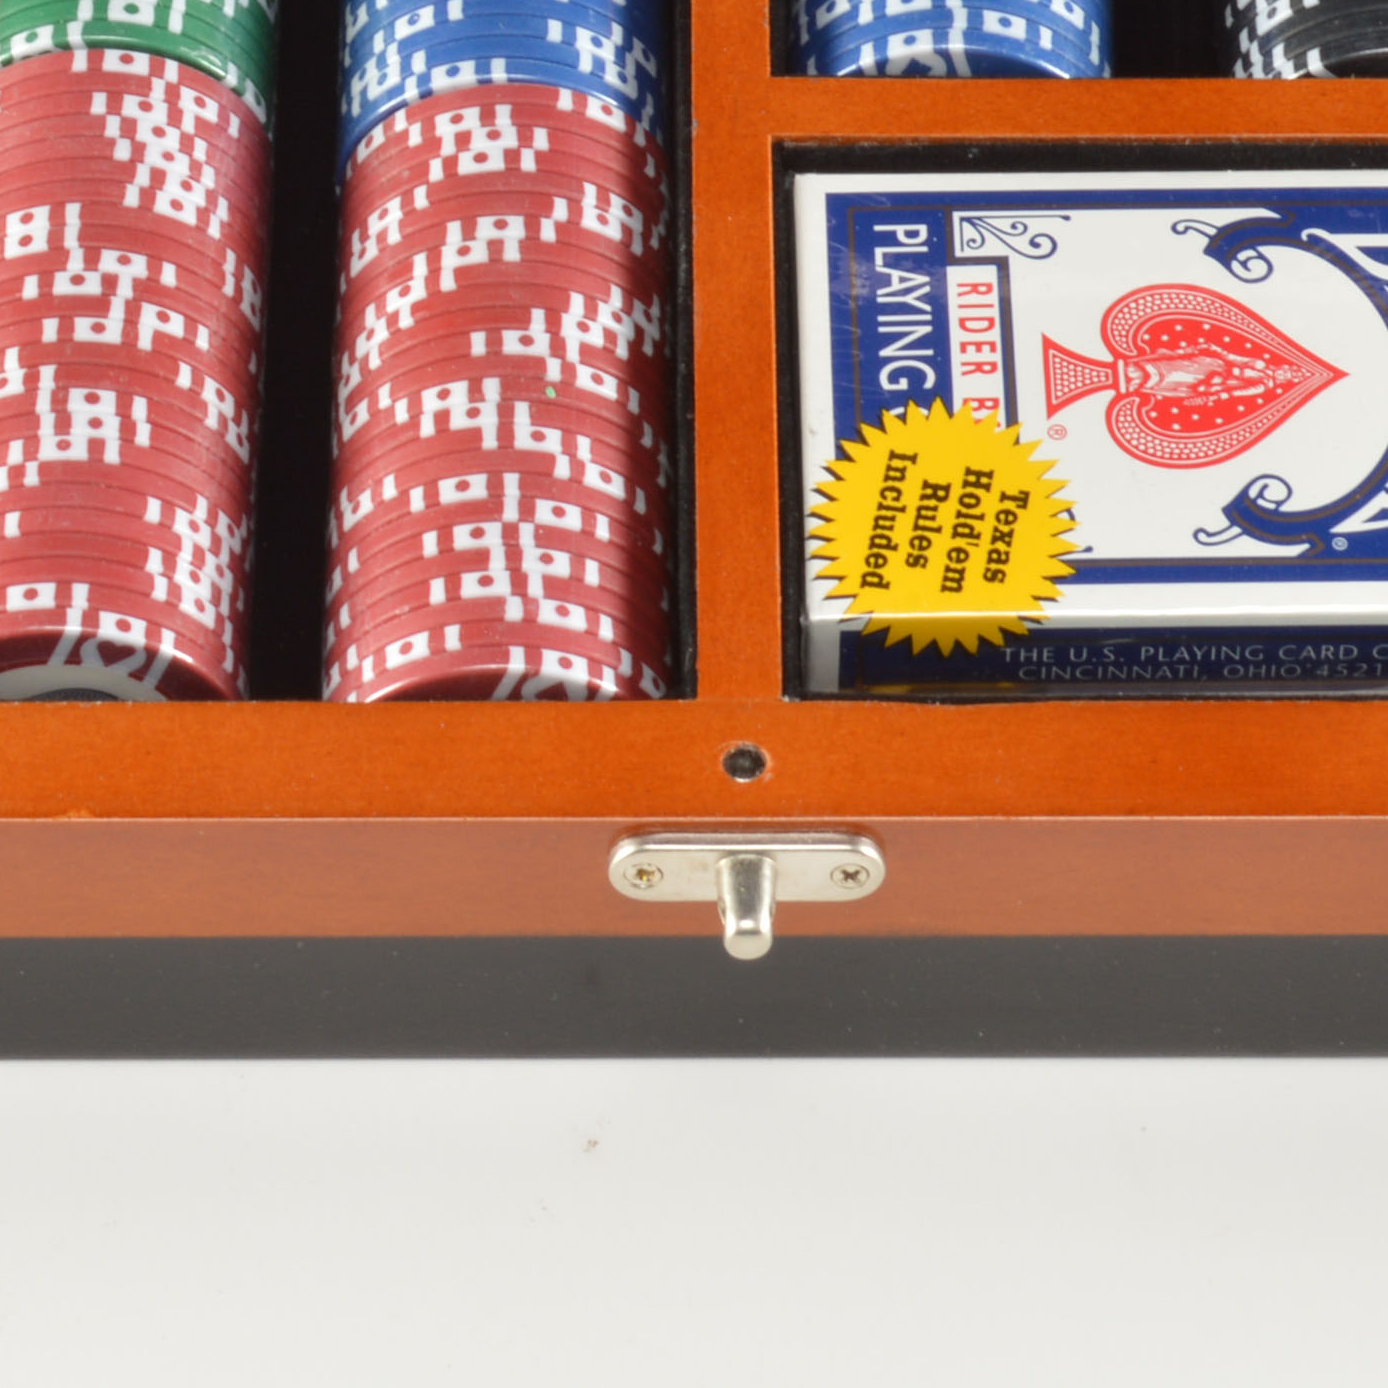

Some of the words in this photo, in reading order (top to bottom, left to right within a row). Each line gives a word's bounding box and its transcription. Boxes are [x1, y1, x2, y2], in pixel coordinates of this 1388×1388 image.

[873, 224, 936, 390] PLAYING
[956, 282, 998, 376] RIDER
[860, 449, 918, 590] Included
[904, 479, 951, 569] Rules
[940, 466, 995, 593] Hold'em
[982, 490, 1030, 584] Texas
[1000, 647, 1055, 663] THE
[1069, 646, 1124, 663] U.S.
[1141, 644, 1265, 661] PLAYING
[1278, 644, 1358, 661] CARD
[1018, 665, 1207, 681] CINCINNATI,
[1223, 663, 1301, 679] OHIO
